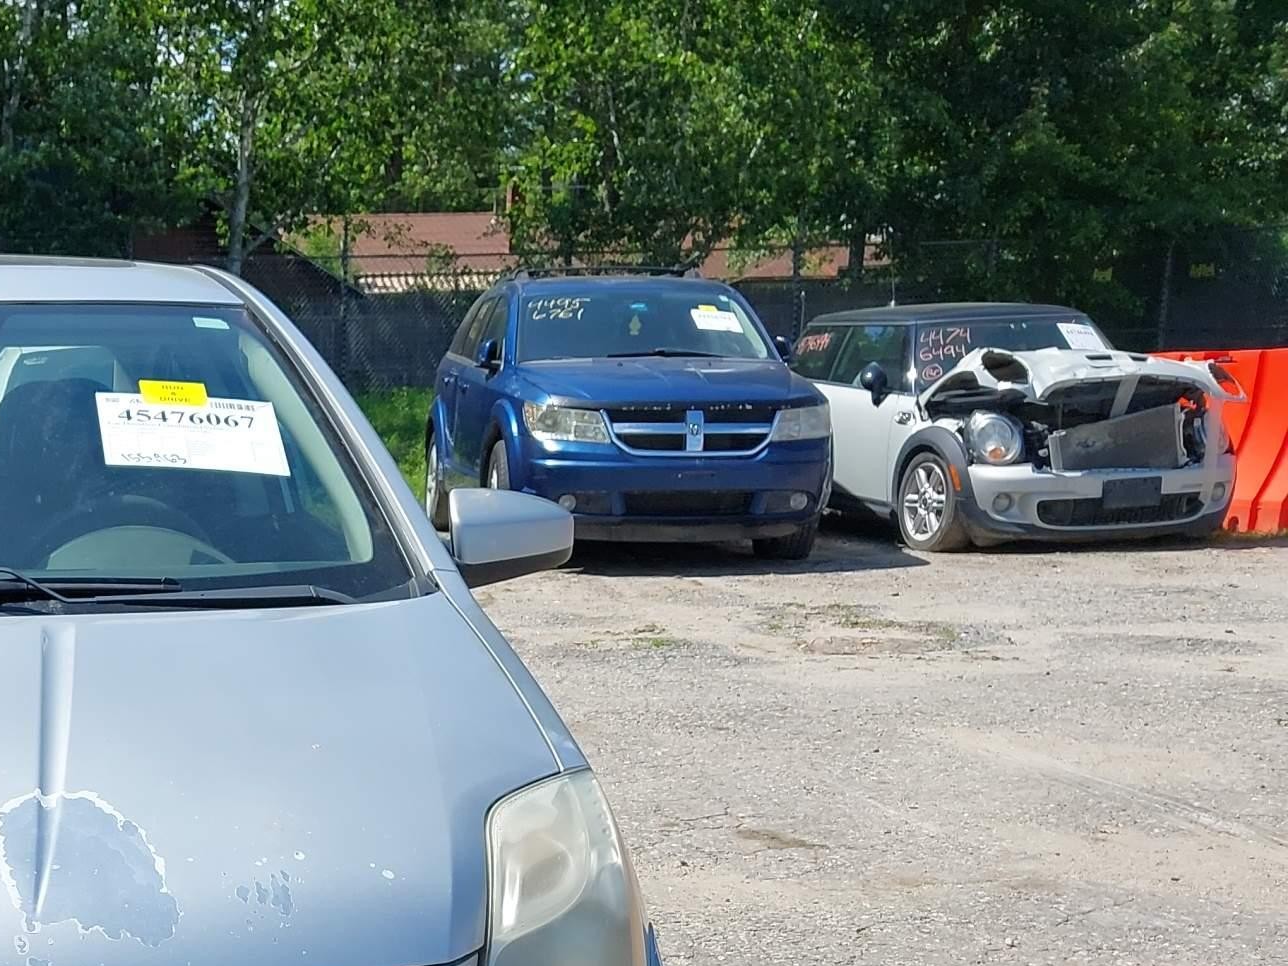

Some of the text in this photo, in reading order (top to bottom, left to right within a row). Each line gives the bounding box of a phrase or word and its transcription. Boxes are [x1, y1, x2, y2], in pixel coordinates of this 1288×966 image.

[919, 327, 971, 347] 4474
[919, 343, 966, 361] 6494
[117, 408, 254, 429] 45476067
